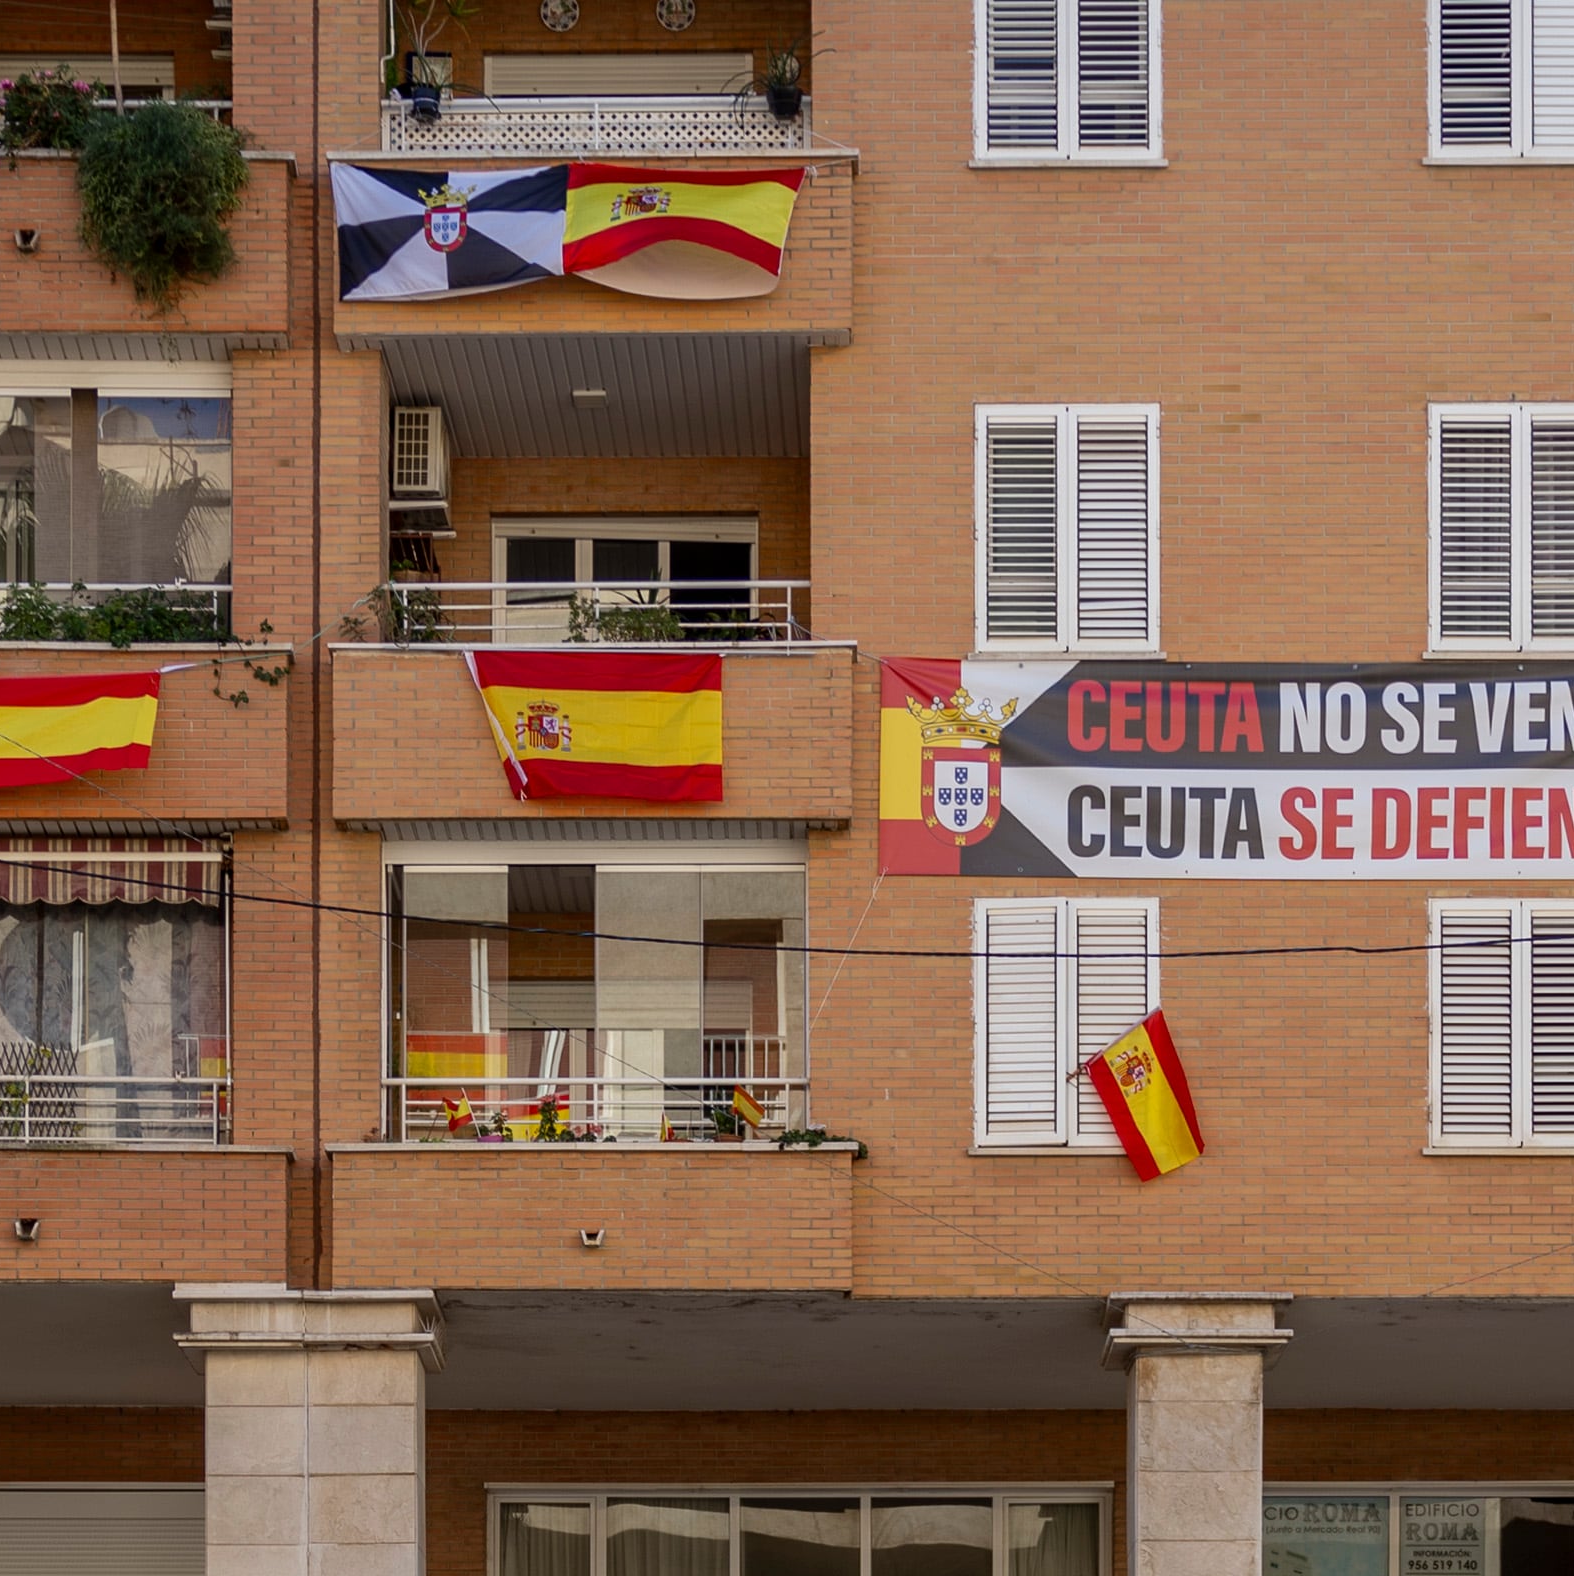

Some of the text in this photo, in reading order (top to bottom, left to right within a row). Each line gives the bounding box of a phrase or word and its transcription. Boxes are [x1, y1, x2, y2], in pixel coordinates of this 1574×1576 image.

[1067, 679, 1265, 754] CEUTA
[1278, 681, 1368, 754] NO
[1380, 681, 1458, 754] SE
[1066, 784, 1265, 861] CEUTA
[1278, 785, 1355, 861] SE
[1303, 1503, 1382, 1523] ROMA
[1405, 1503, 1480, 1517] EDIFICIO
[1303, 1525, 1342, 1534] Mercado
[1346, 1525, 1365, 1534] Real
[1405, 1522, 1480, 1542] ROMA
[1408, 1560, 1478, 1570] 956 519 140
